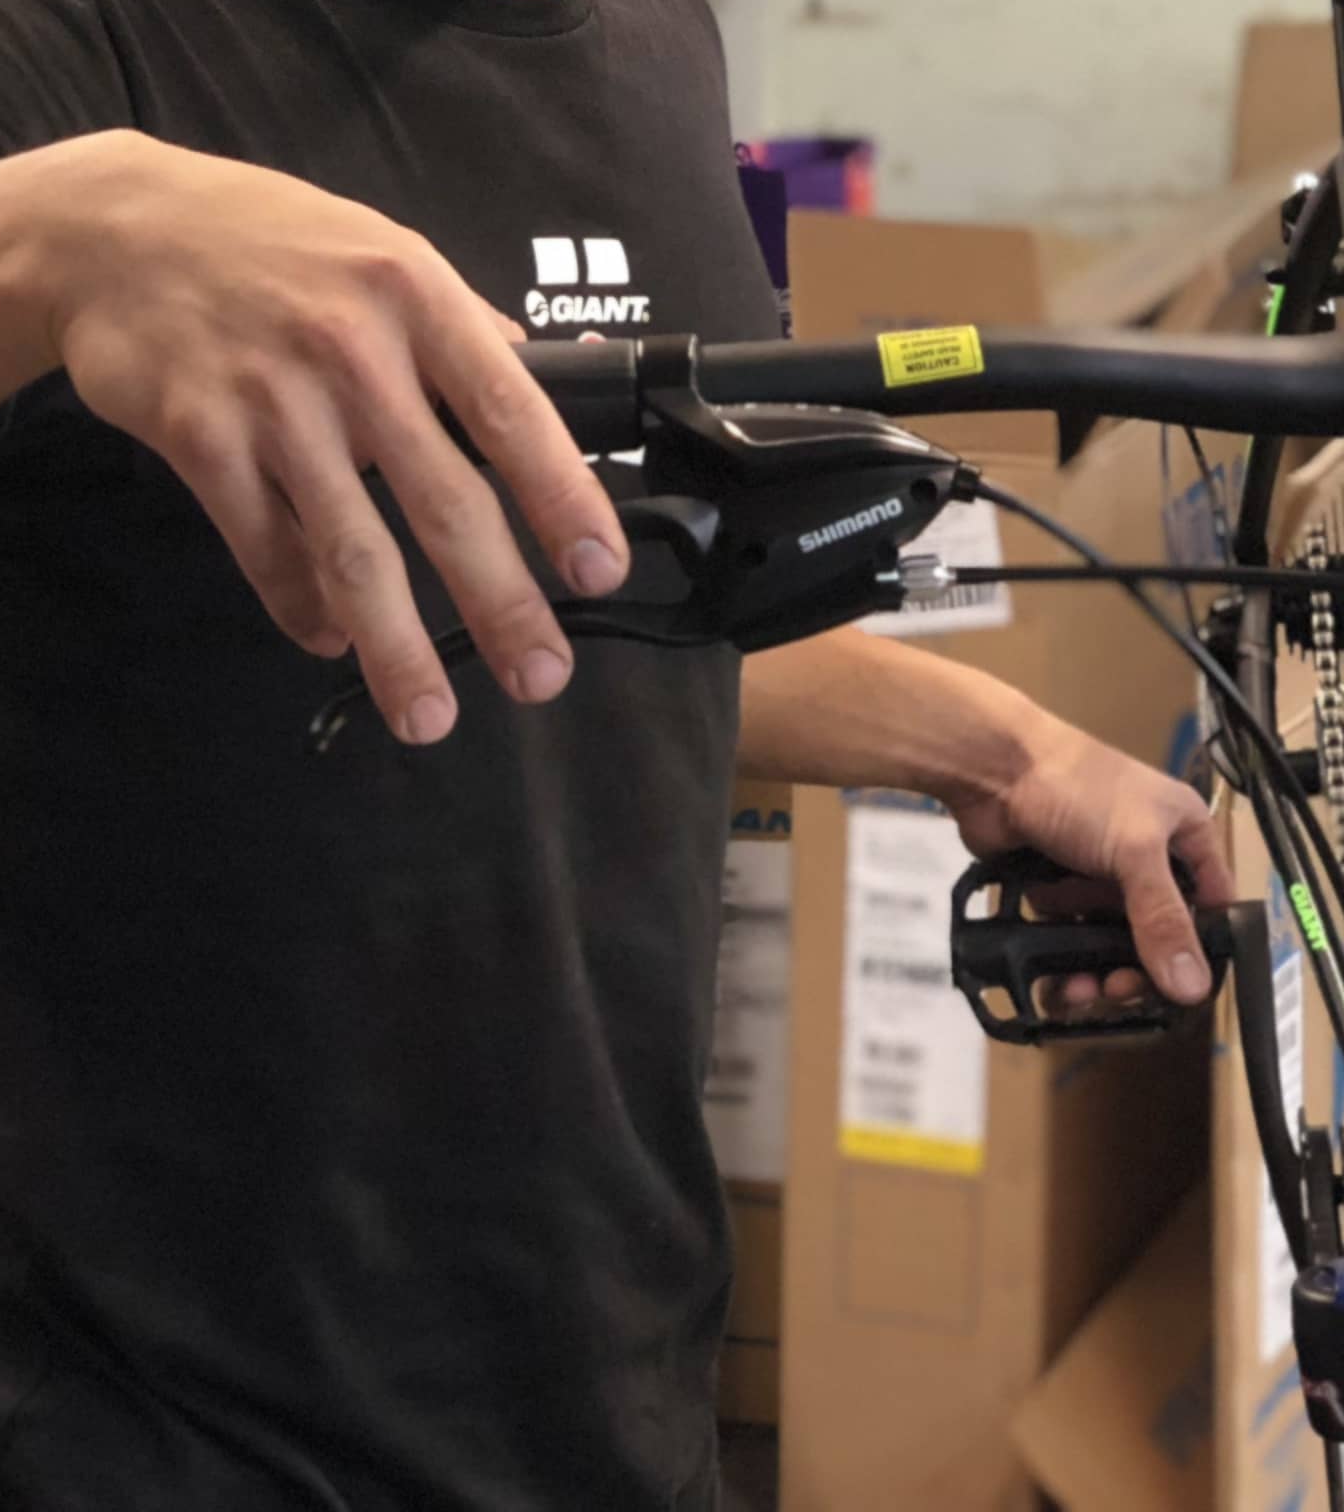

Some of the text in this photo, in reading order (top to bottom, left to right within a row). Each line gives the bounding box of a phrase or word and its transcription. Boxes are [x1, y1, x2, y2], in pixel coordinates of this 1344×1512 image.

[551, 295, 650, 324] GIANT
[905, 355, 960, 373] CAUTION
[798, 496, 904, 554] SHIMANO
[1290, 881, 1326, 951] GIANT
